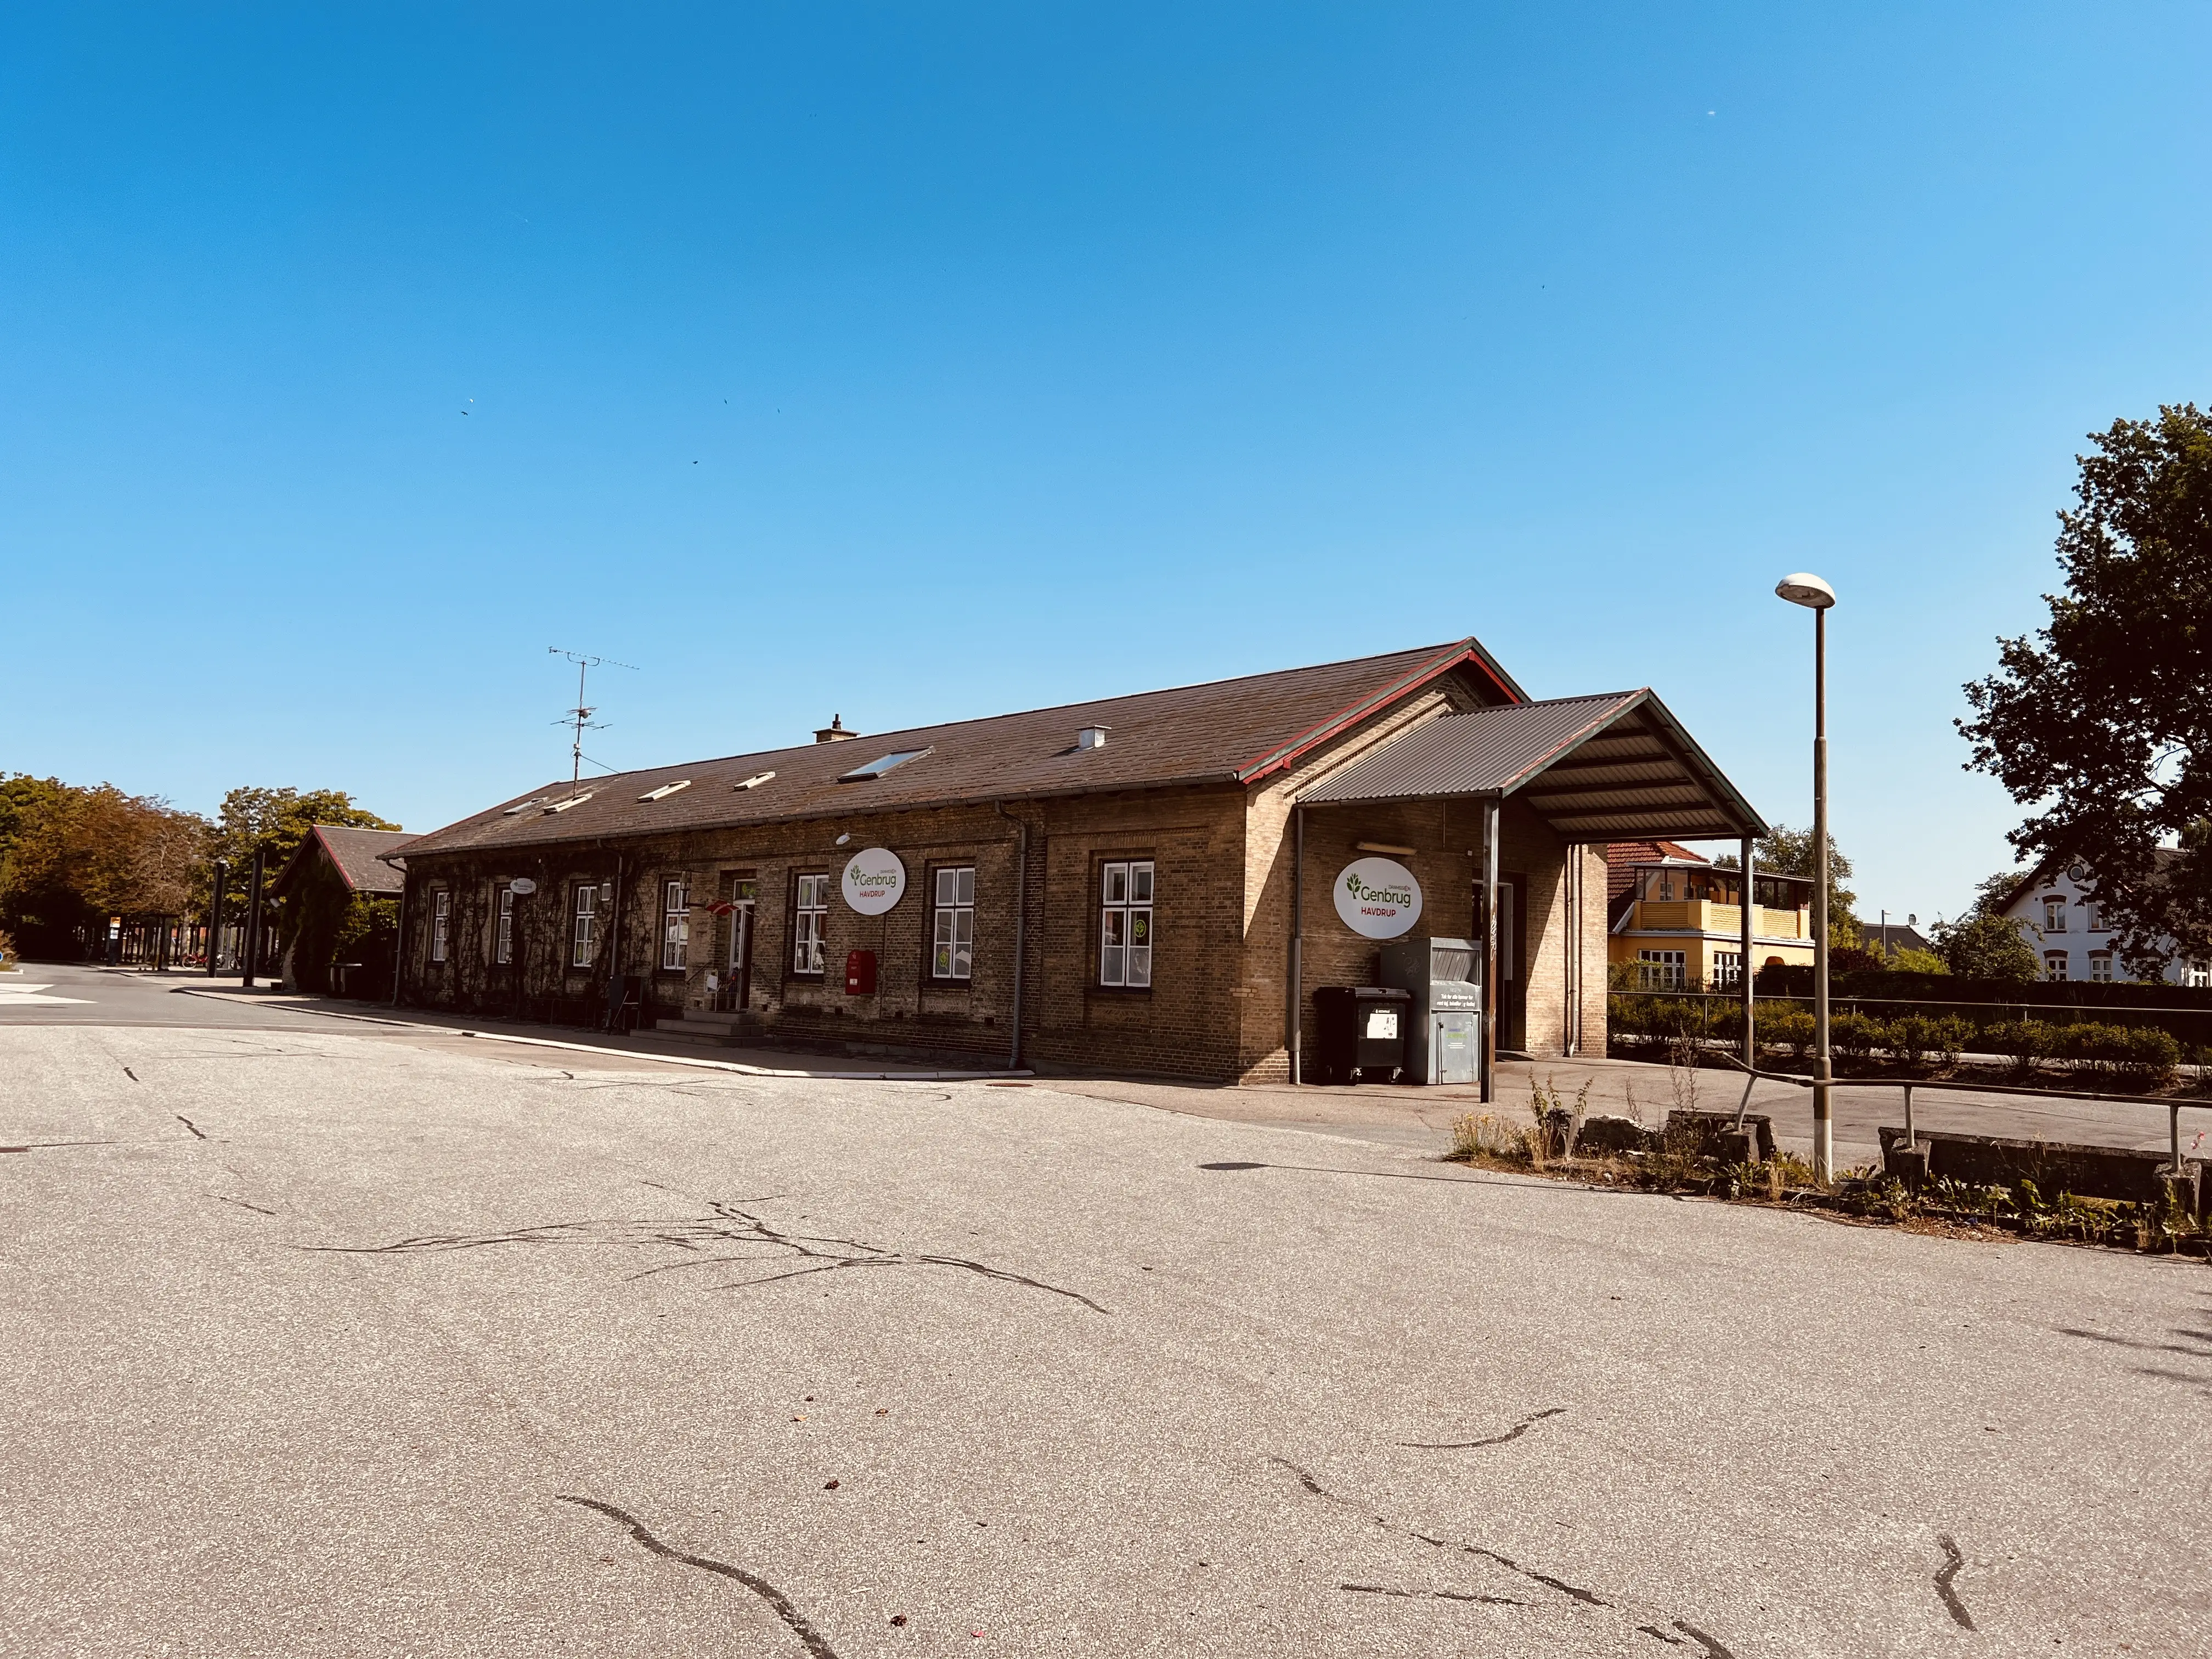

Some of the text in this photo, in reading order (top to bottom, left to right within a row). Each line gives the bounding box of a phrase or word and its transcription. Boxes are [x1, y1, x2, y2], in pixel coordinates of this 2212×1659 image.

[860, 873, 896, 888] Genbrug
[1361, 886, 1411, 908] Genbrug
[1361, 907, 1396, 917] HAVDRUP
